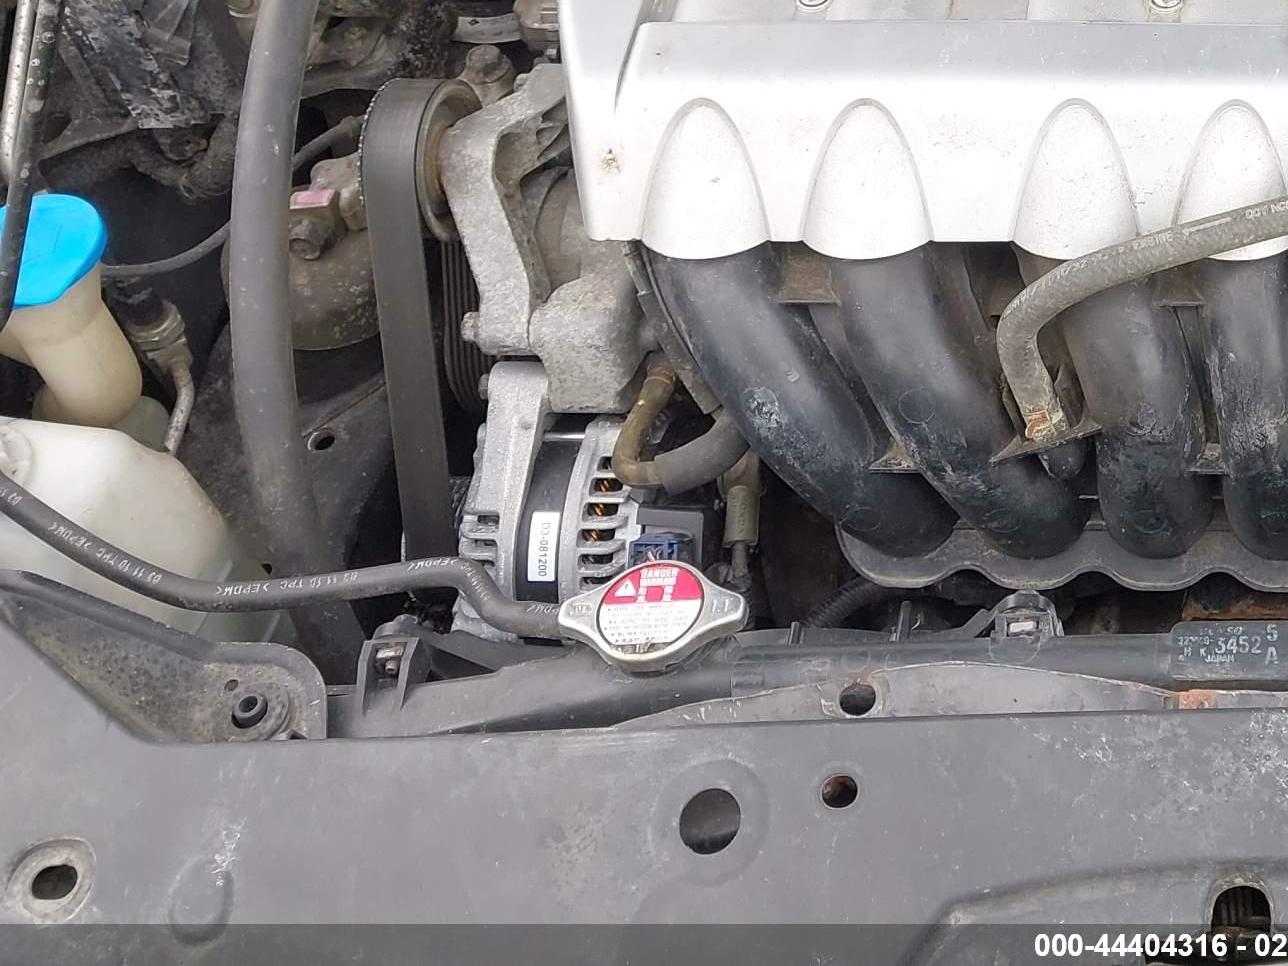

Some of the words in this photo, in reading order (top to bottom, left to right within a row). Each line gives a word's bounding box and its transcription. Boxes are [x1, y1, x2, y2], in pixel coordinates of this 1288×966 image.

[640, 569, 679, 579] DANGER
[279, 580, 304, 590] TPC
[1266, 624, 1278, 641] 5
[1215, 635, 1262, 654] 3452
[1205, 654, 1235, 663] JAPAN
[1265, 646, 1278, 665] A
